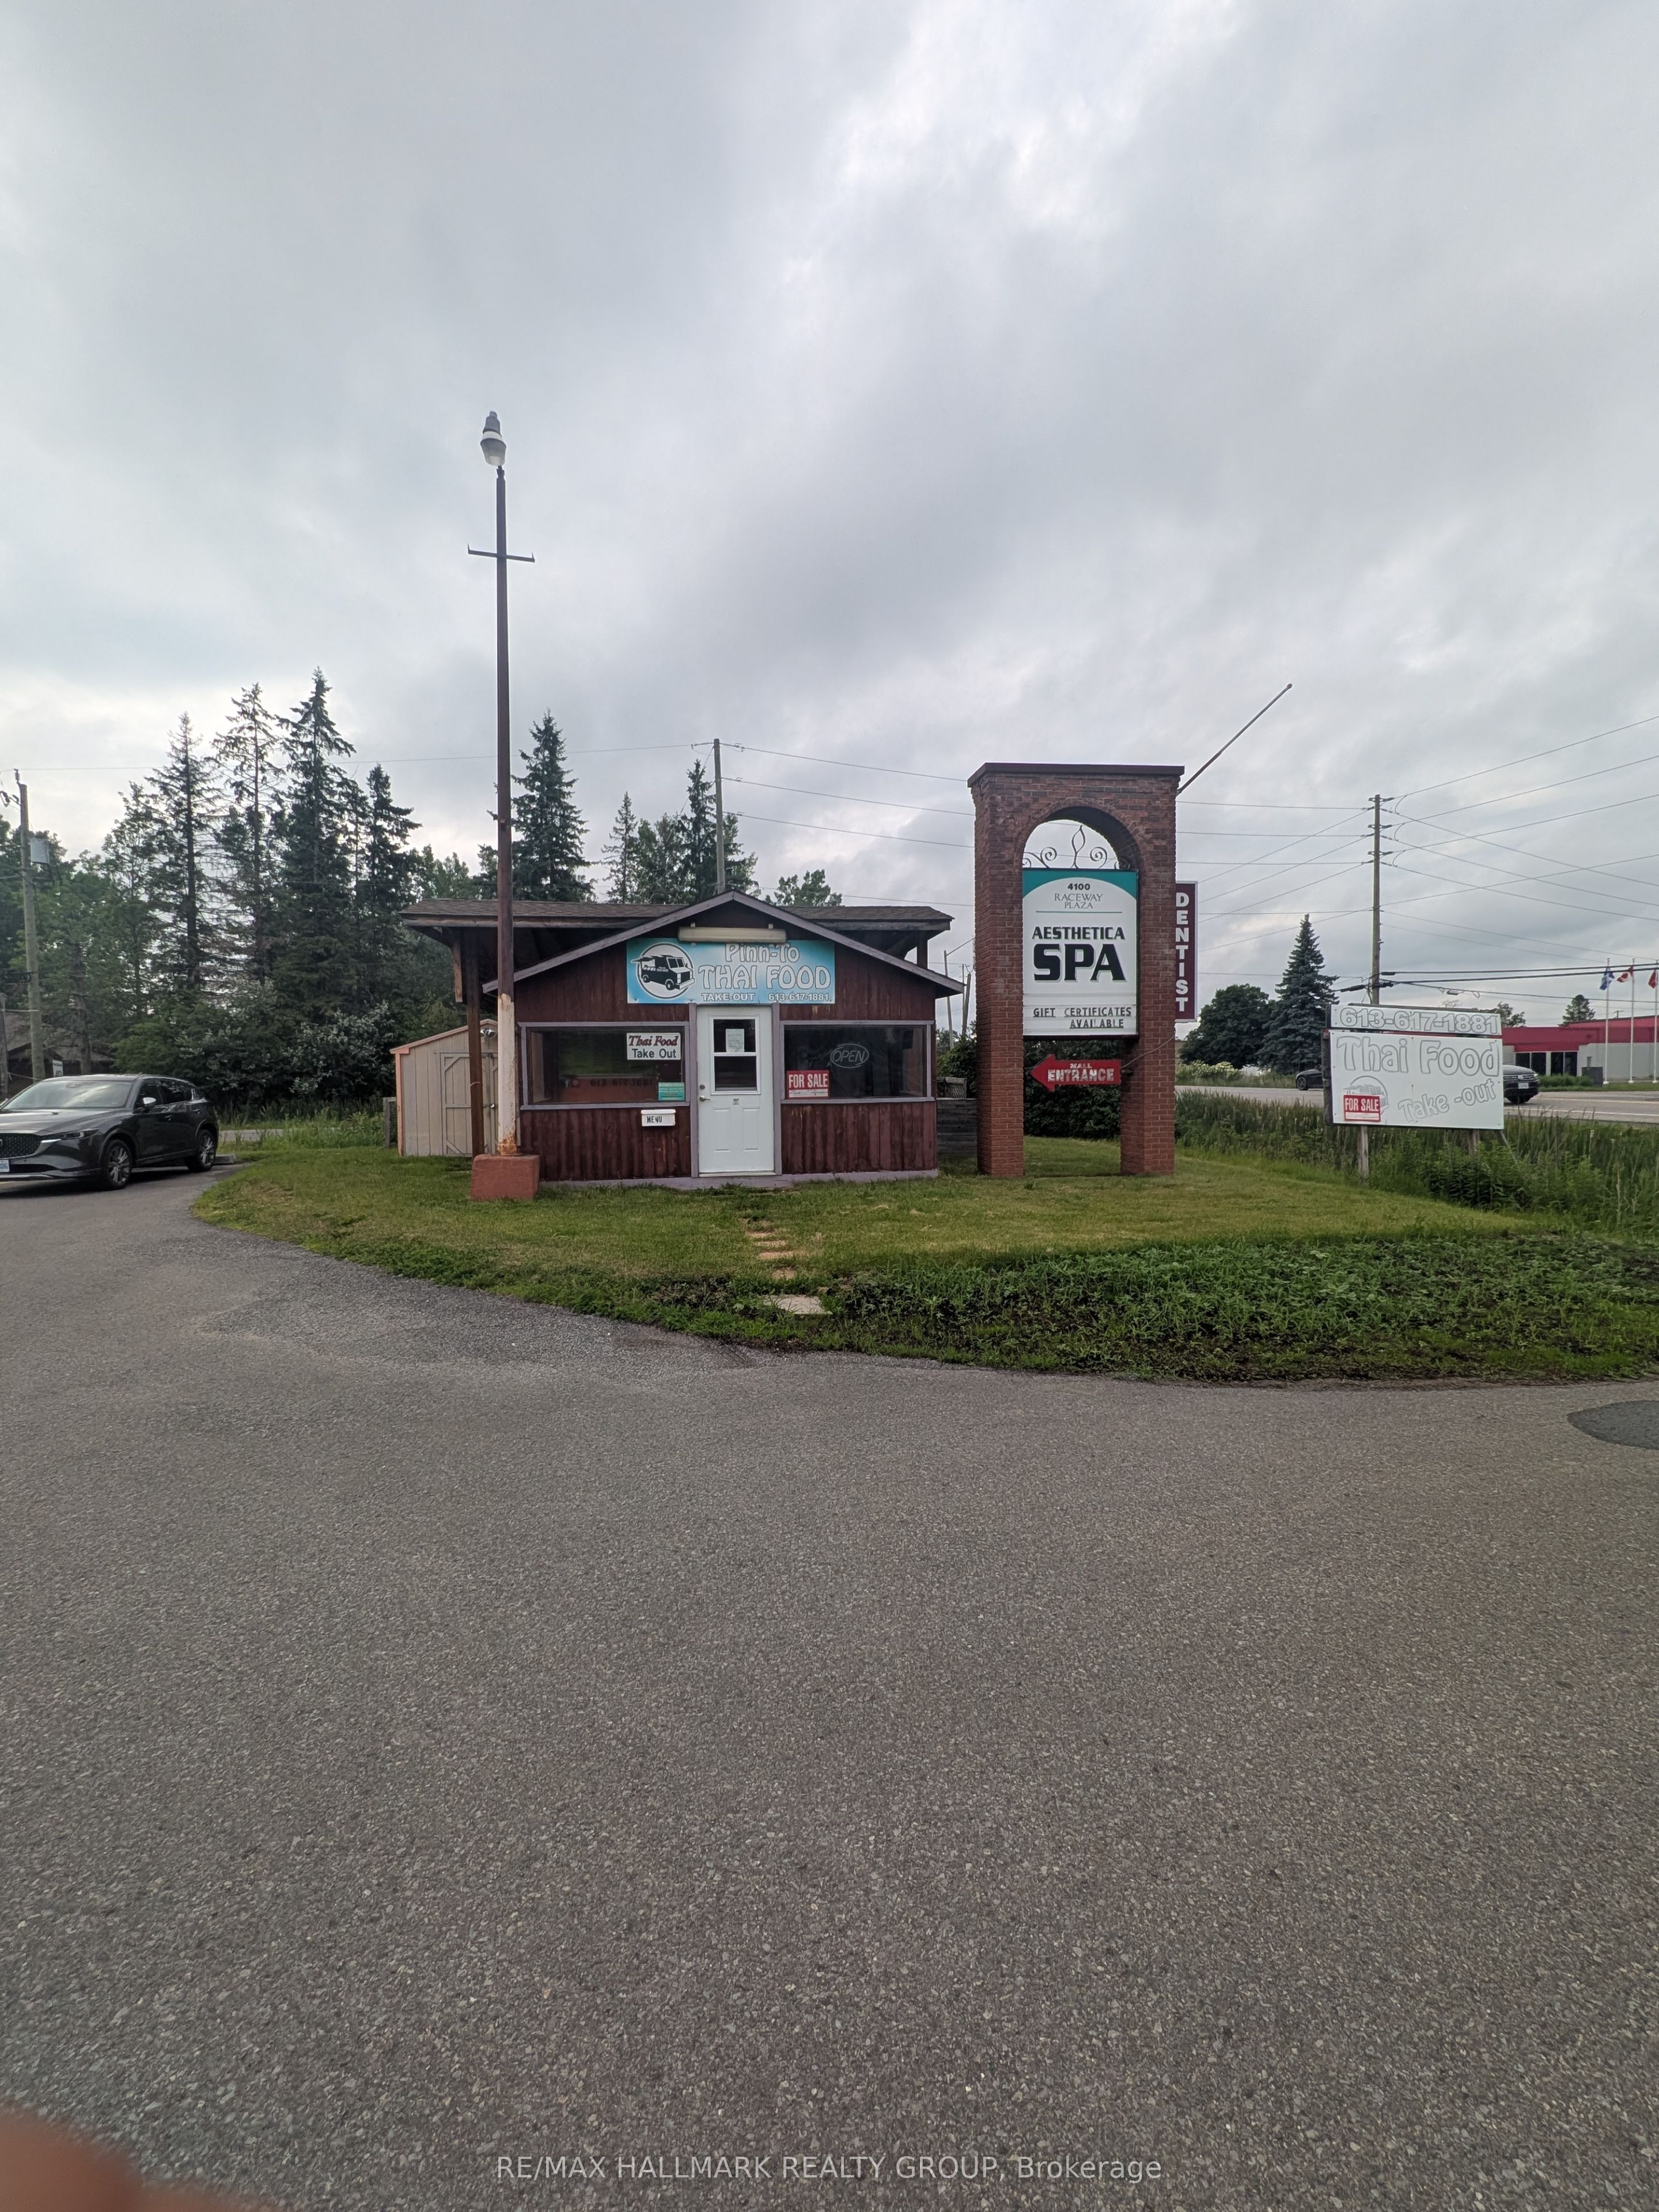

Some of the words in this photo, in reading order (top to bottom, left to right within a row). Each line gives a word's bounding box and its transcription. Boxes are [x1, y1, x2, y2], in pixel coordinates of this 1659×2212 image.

[1054, 893, 1103, 902] RACEWAY
[1032, 926, 1125, 940] AESTHETICA
[725, 943, 800, 963] Pinn-To
[1175, 892, 1190, 1012] DENTIST
[1033, 944, 1127, 982] SPA
[698, 964, 758, 990] THAI
[766, 965, 831, 990] FOOD
[702, 993, 755, 1002] TAKE-OUT
[768, 993, 829, 1002] 613-617-1881
[1033, 1008, 1055, 1017] GIFT
[1064, 1007, 1132, 1017] CERTIFICATES
[1070, 1019, 1124, 1029] AVAILABLE
[1340, 1007, 1498, 1034] 613-617-1881
[628, 1035, 653, 1046] Thai
[653, 1035, 679, 1046] Food
[632, 1048, 654, 1058] Take
[659, 1048, 676, 1058] Out
[832, 1050, 865, 1062] OPEN
[1336, 1036, 1408, 1073] Thai
[1419, 1039, 1499, 1077] Food
[789, 1074, 805, 1088] FOR
[807, 1073, 828, 1088] SALE
[1047, 1069, 1115, 1082] ENTRANCE
[1344, 1098, 1359, 1111] FOR
[1361, 1099, 1379, 1112] SALE
[646, 1116, 662, 1124] MENU
